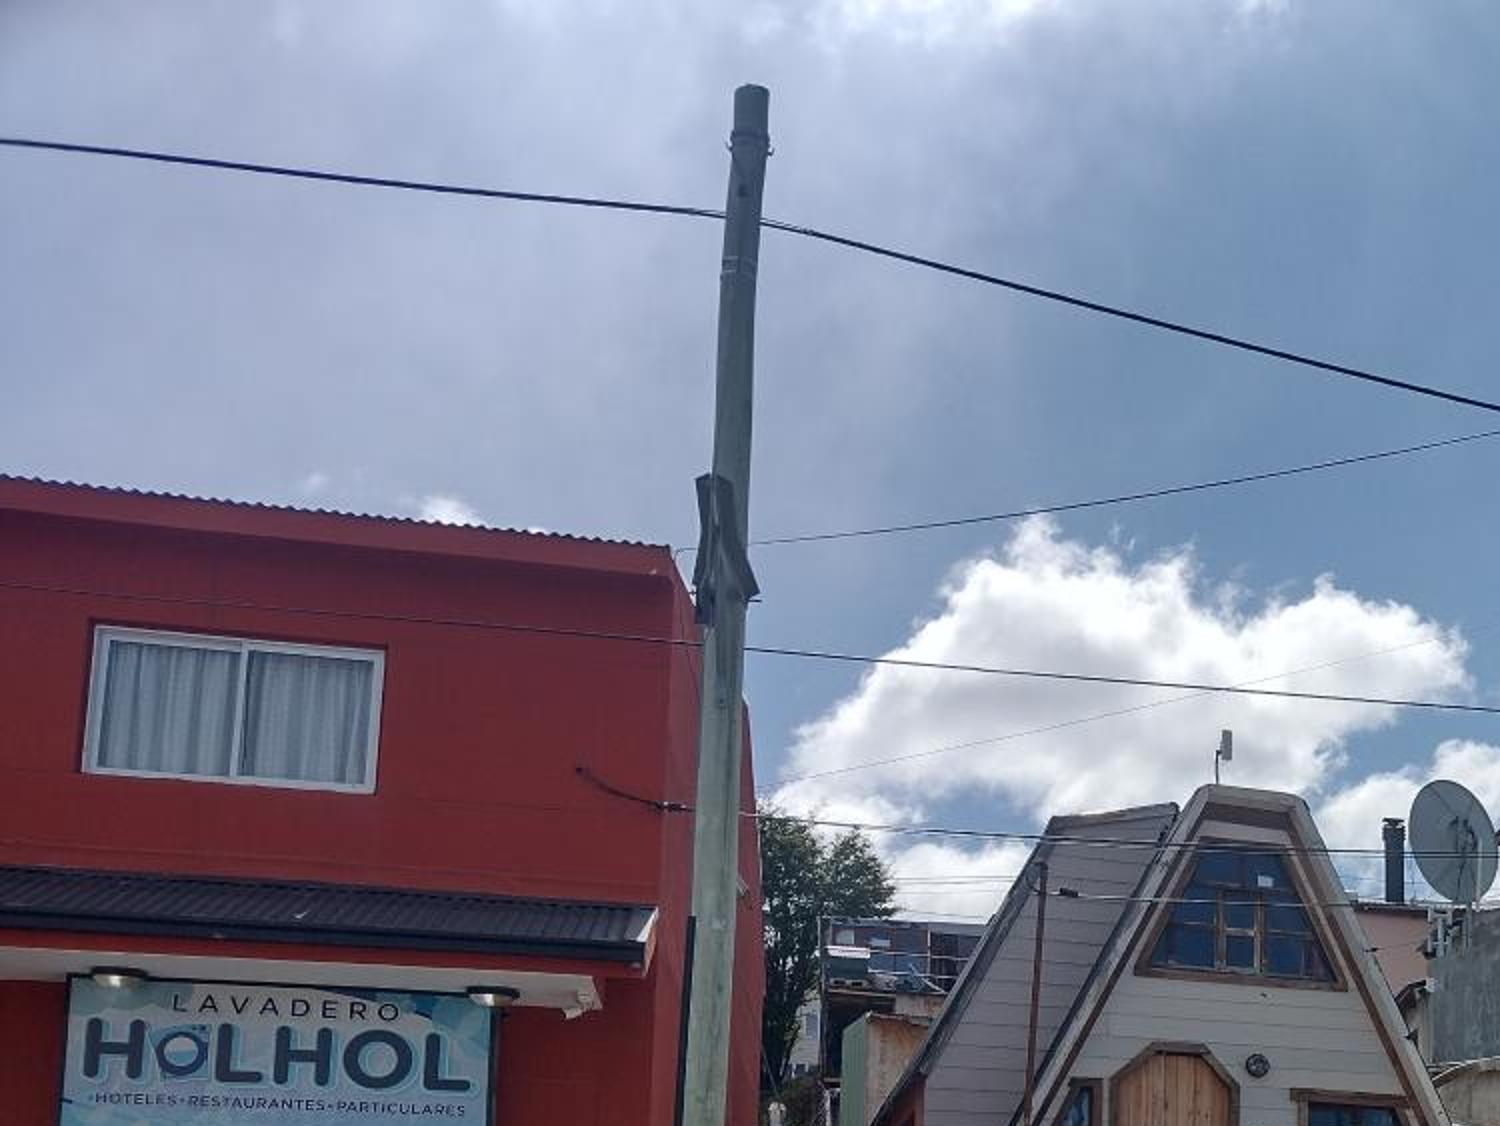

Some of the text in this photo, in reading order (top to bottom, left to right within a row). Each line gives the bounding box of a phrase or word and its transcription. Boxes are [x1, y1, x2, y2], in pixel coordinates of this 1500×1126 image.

[172, 994, 400, 1022] LAVADERO
[95, 1093, 466, 1117] HOTELES RESTAURANTES PARTICULARES
